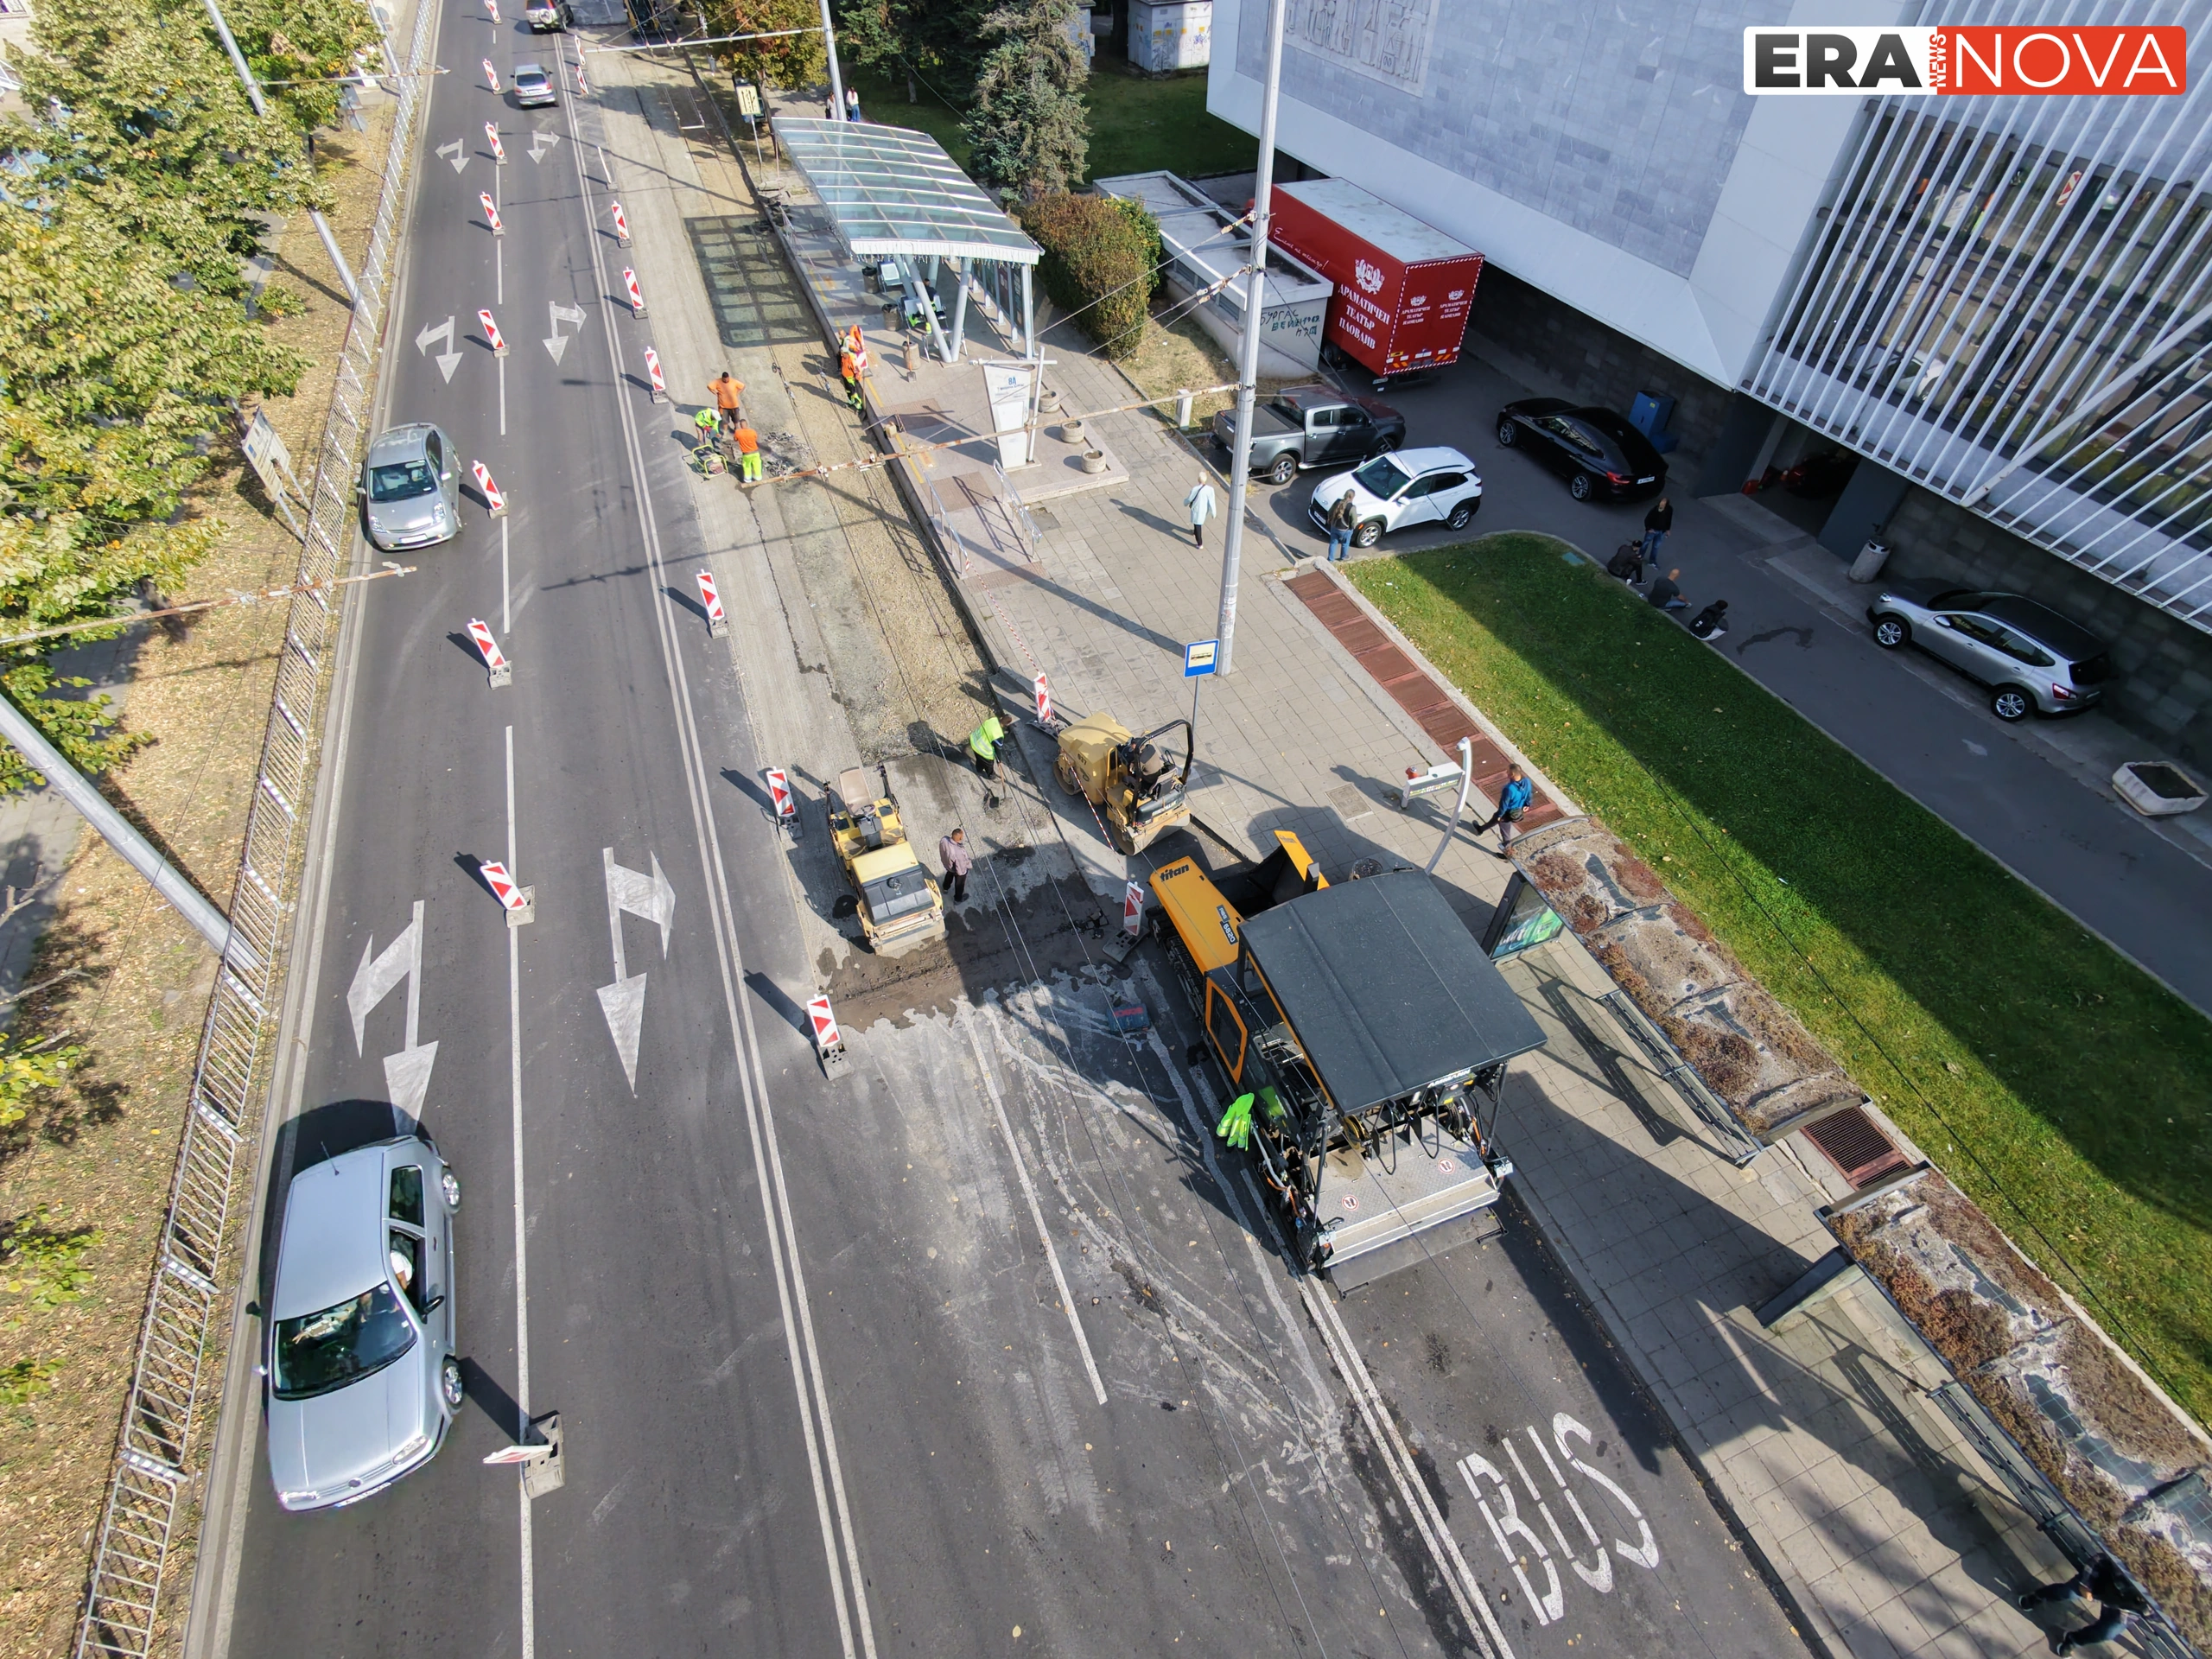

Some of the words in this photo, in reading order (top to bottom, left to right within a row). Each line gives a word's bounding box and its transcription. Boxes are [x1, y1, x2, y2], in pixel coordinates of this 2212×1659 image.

[1260, 309, 1299, 326] БУРГАС
[1338, 283, 1390, 325] ДРАМАТИЧЕН
[1346, 304, 1375, 331] ТЕАТЪР
[1338, 317, 1376, 350] ПЛОВДИВ
[1160, 864, 1190, 882] titan
[1223, 923, 1236, 943] 6820
[1456, 1412, 1659, 1626] BUS
